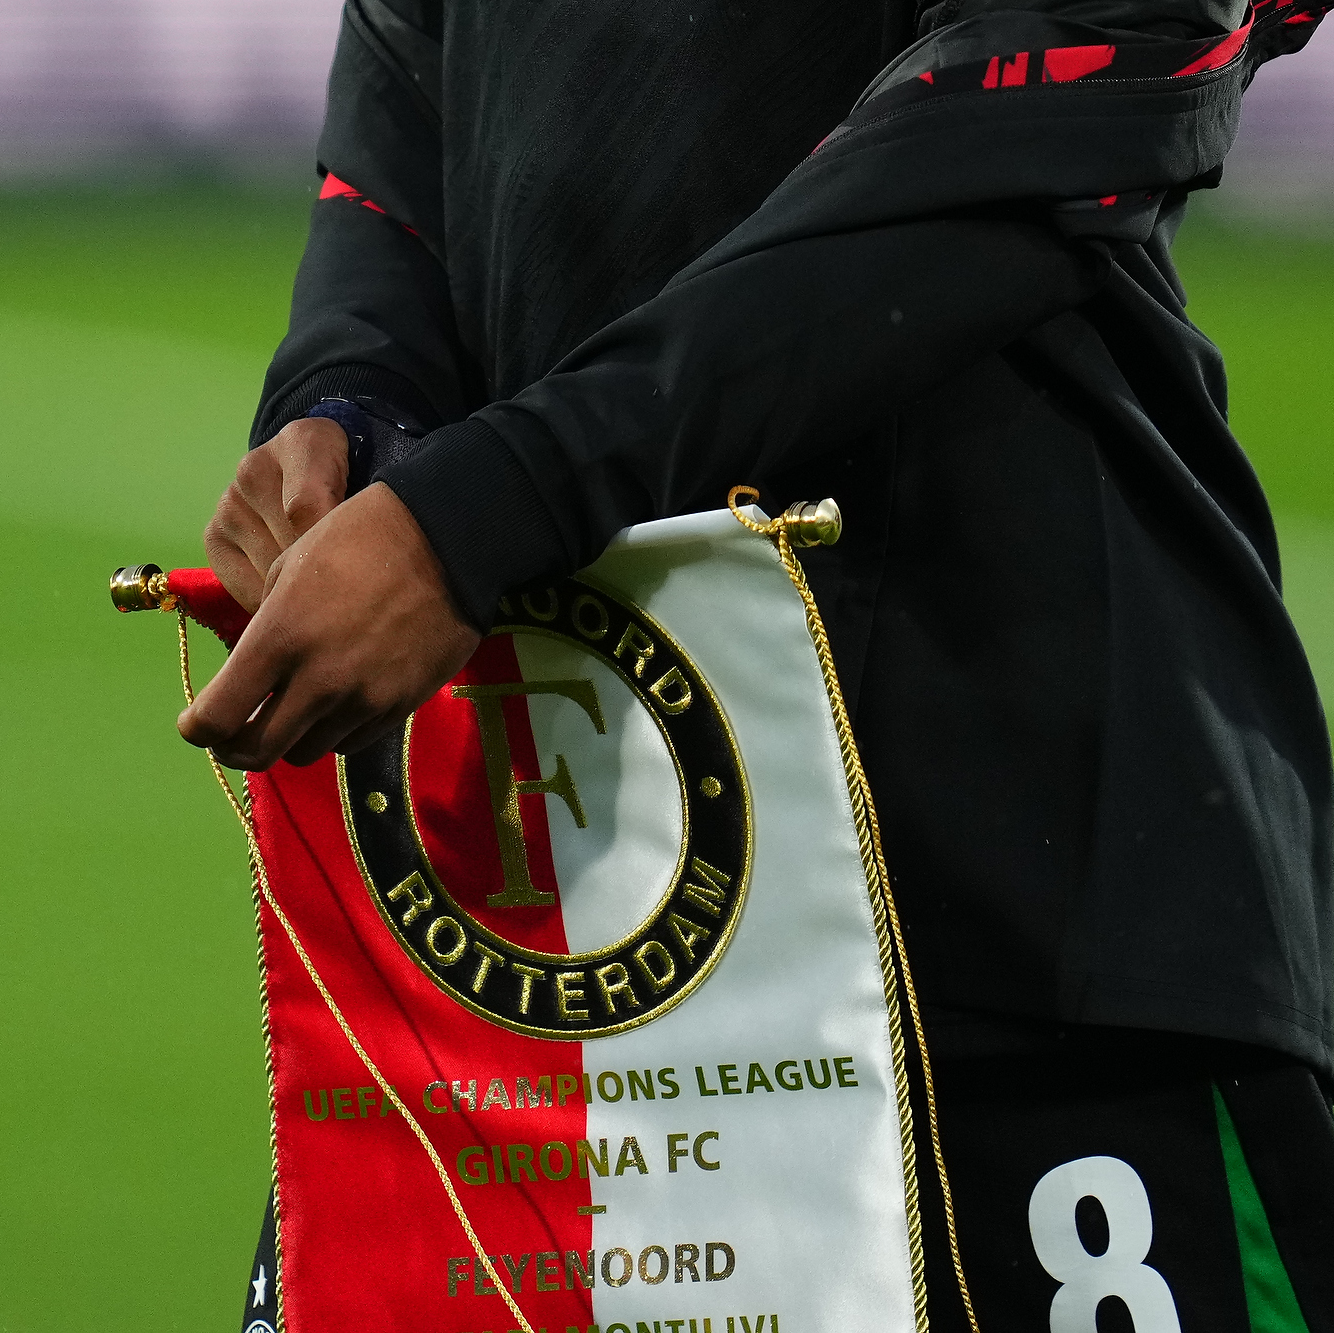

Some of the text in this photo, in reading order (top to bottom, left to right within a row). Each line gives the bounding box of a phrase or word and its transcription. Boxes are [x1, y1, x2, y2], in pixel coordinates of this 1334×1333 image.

[387, 856, 732, 1021] ROTTERDAM
[423, 1067, 680, 1114] CHAMPIONS
[695, 1056, 859, 1097] LEAGUE
[456, 1131, 720, 1185] GIRONA FC
[447, 1242, 735, 1297] FEYENOORD
[1028, 1155, 1182, 1333] 8
